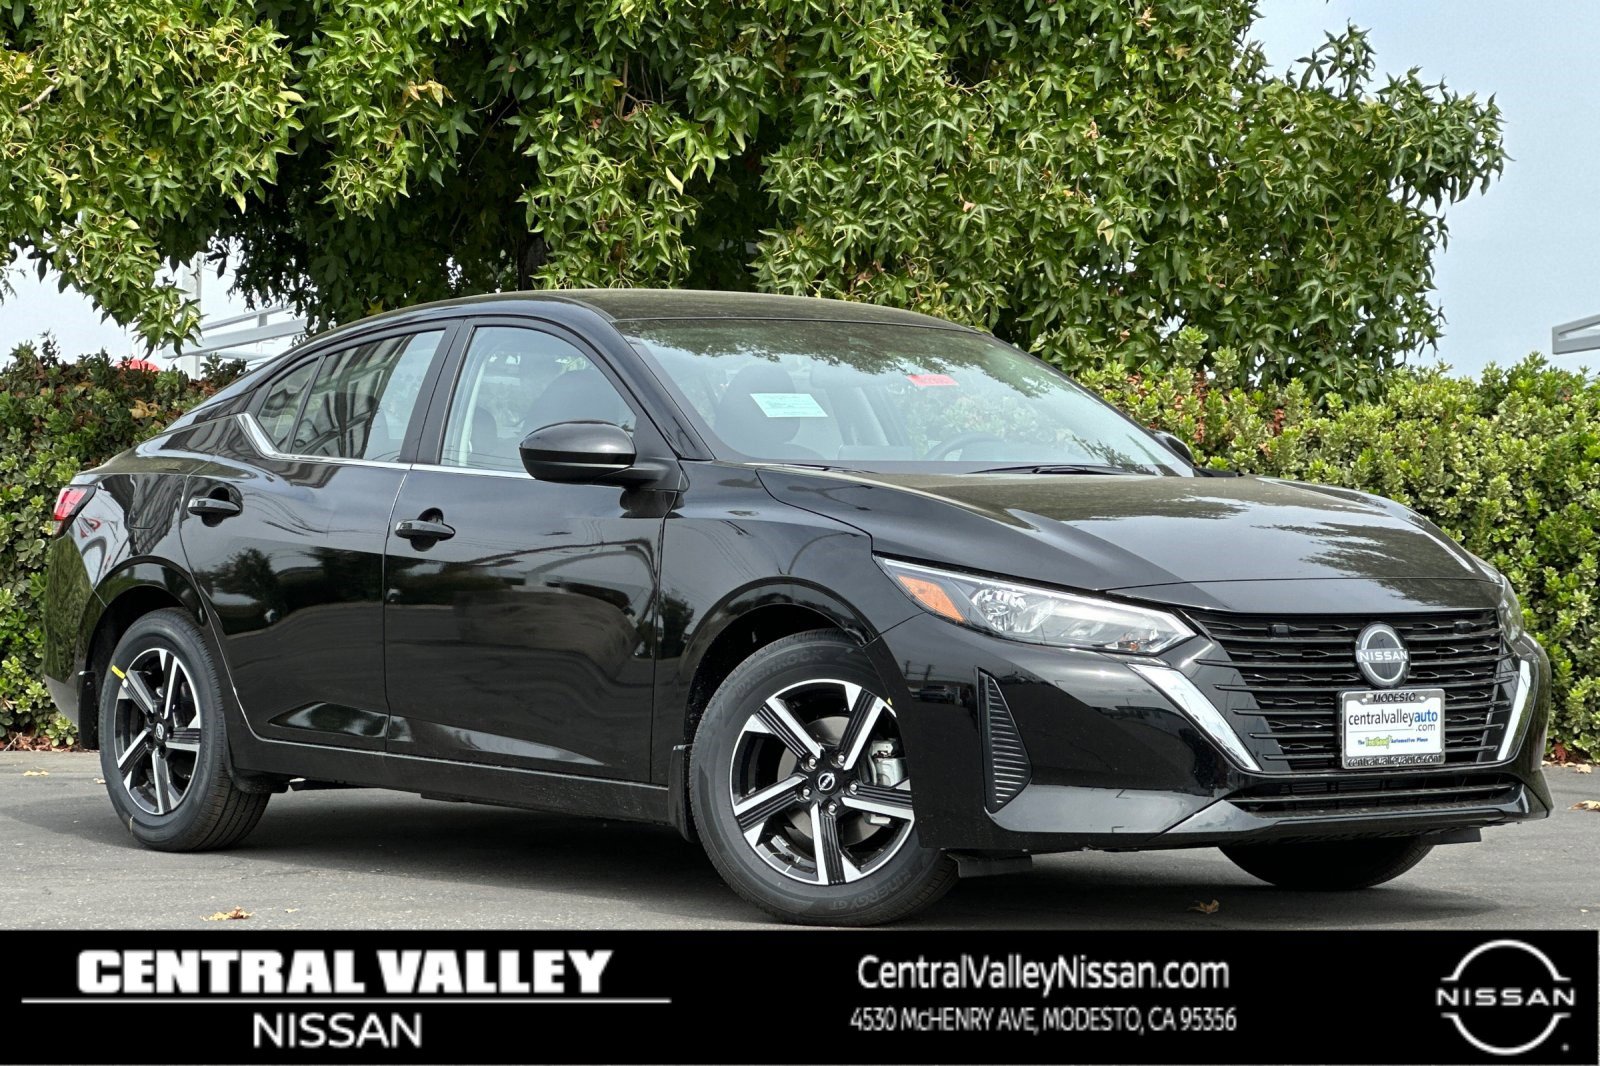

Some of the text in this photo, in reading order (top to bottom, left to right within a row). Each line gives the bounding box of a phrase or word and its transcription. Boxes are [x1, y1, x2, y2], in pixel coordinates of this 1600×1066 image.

[1359, 651, 1408, 661] NISSAN
[1372, 692, 1416, 703] MODESTO
[1348, 708, 1438, 727] centralvalleyauto
[1415, 723, 1436, 732] .com
